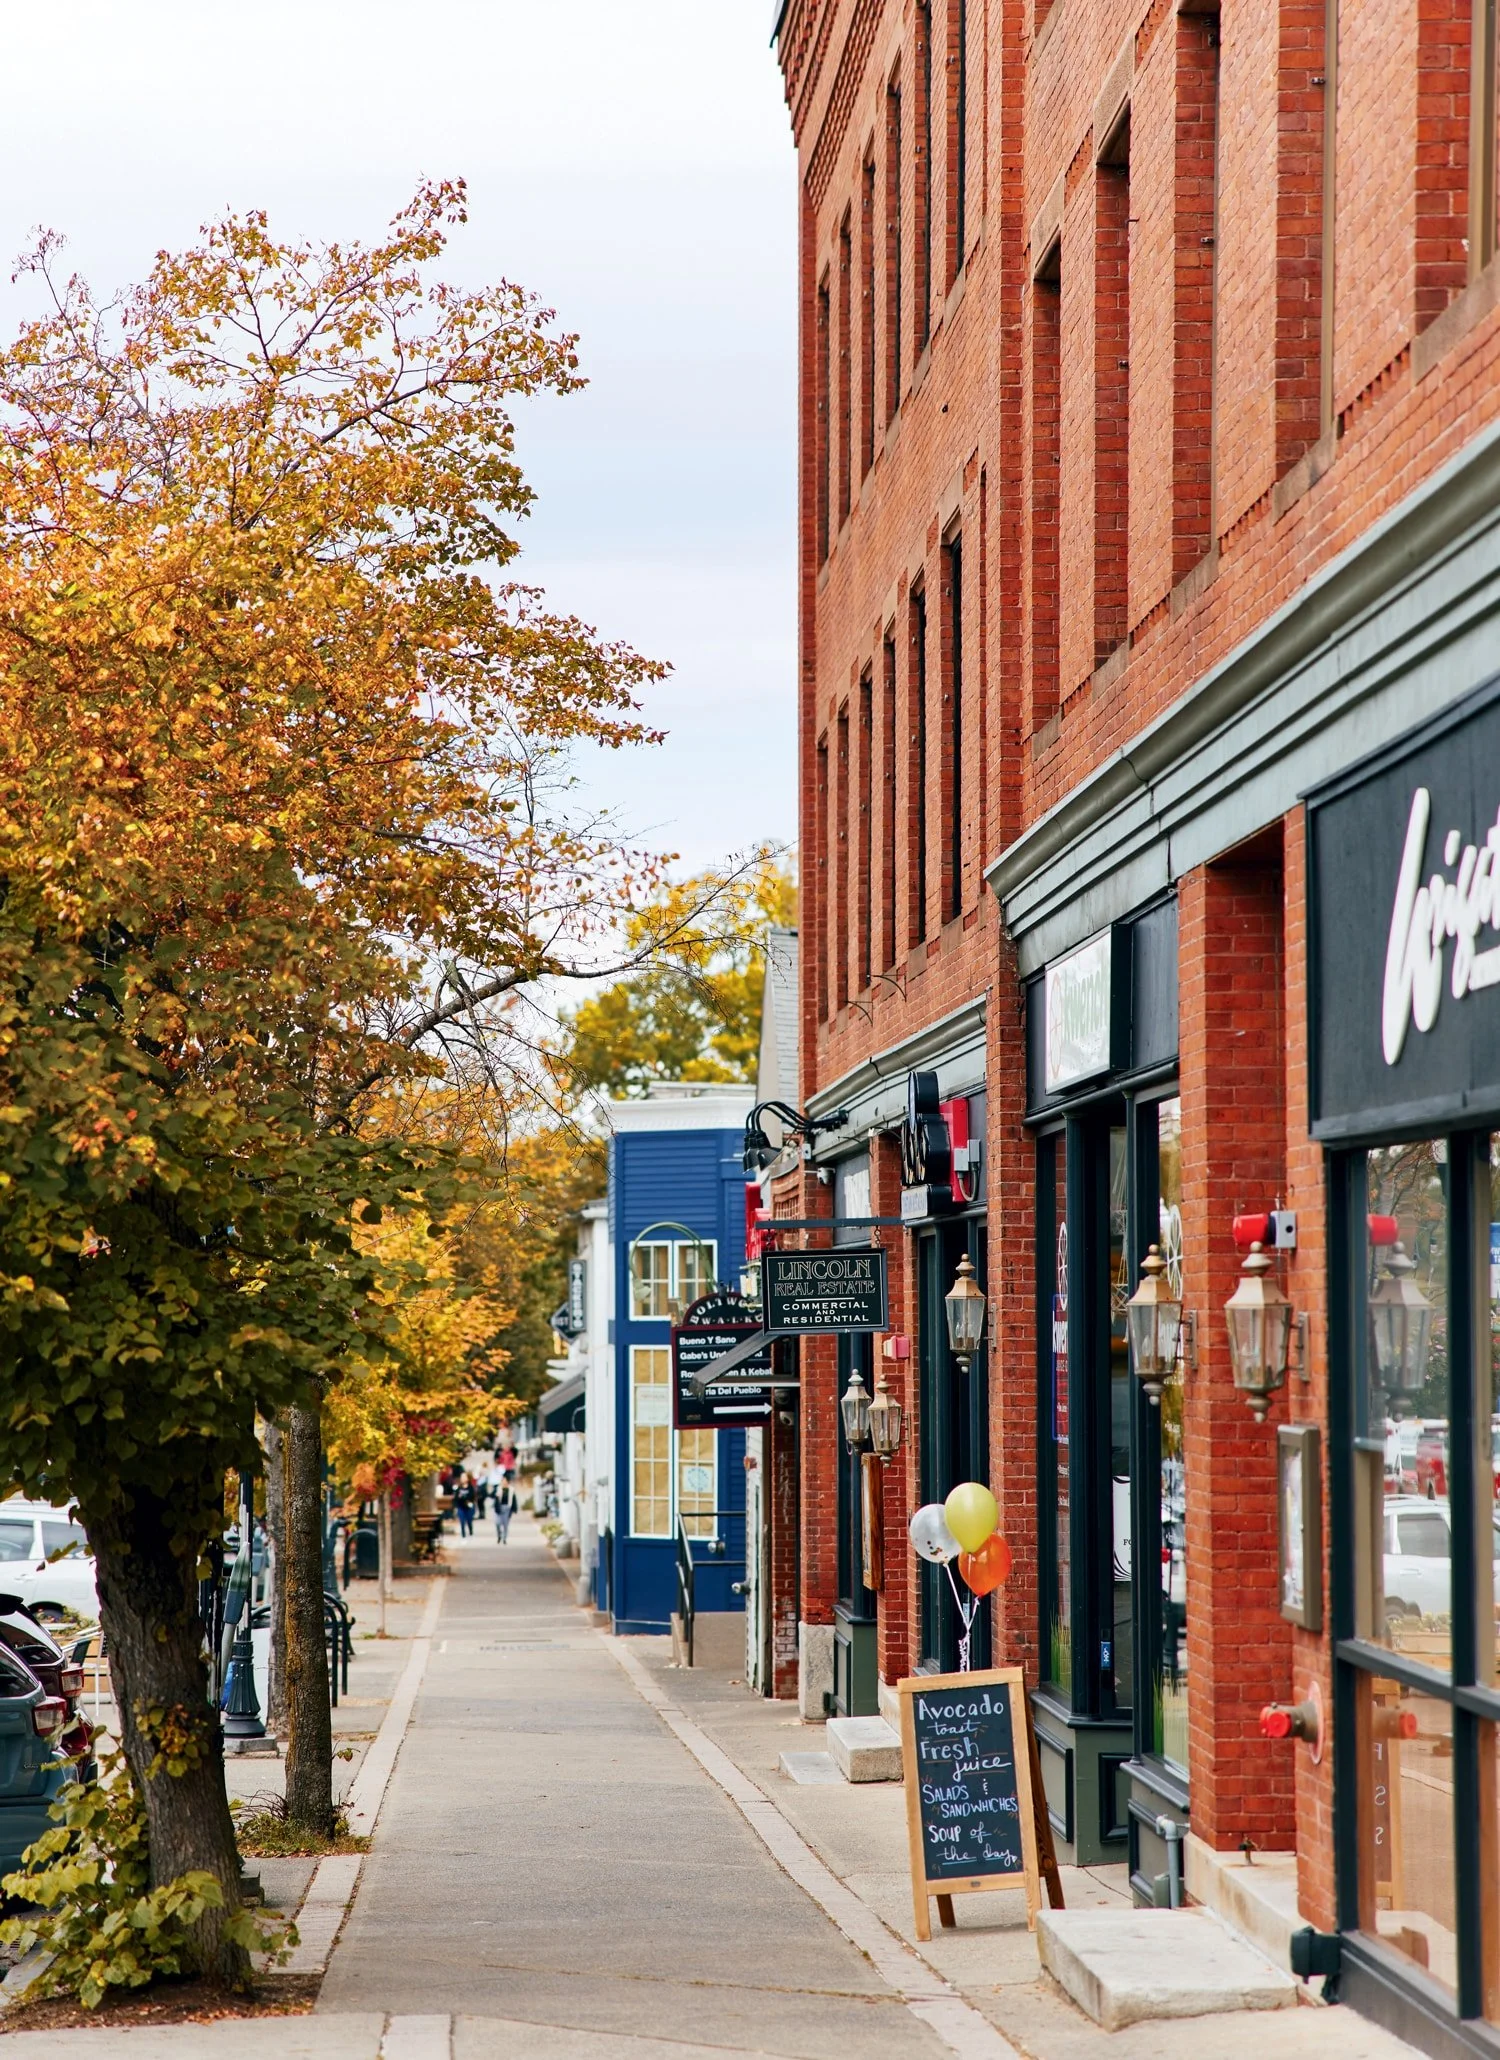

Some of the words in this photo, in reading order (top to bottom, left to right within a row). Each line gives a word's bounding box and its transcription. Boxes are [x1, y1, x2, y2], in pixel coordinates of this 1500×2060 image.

[777, 1260, 872, 1281] LINCOLN
[774, 1282, 815, 1297] REAL
[817, 1280, 876, 1296] ESTATE
[782, 1301, 869, 1311] COMMERCIAL
[783, 1315, 869, 1324] RESIDENTIAL
[680, 1337, 706, 1346] Bueno
[707, 1336, 714, 1344] Y
[715, 1336, 737, 1344] Sano
[680, 1351, 708, 1360] Gabe's
[740, 1368, 747, 1376] &
[718, 1386, 732, 1395] Del
[919, 1694, 1004, 1720] Avocado
[927, 1720, 981, 1735] toast
[920, 1737, 979, 1760] Fresh
[953, 1757, 1011, 1782] juice
[970, 1821, 988, 1844] of
[936, 1845, 977, 1861] the
[983, 1843, 1011, 1867] day
